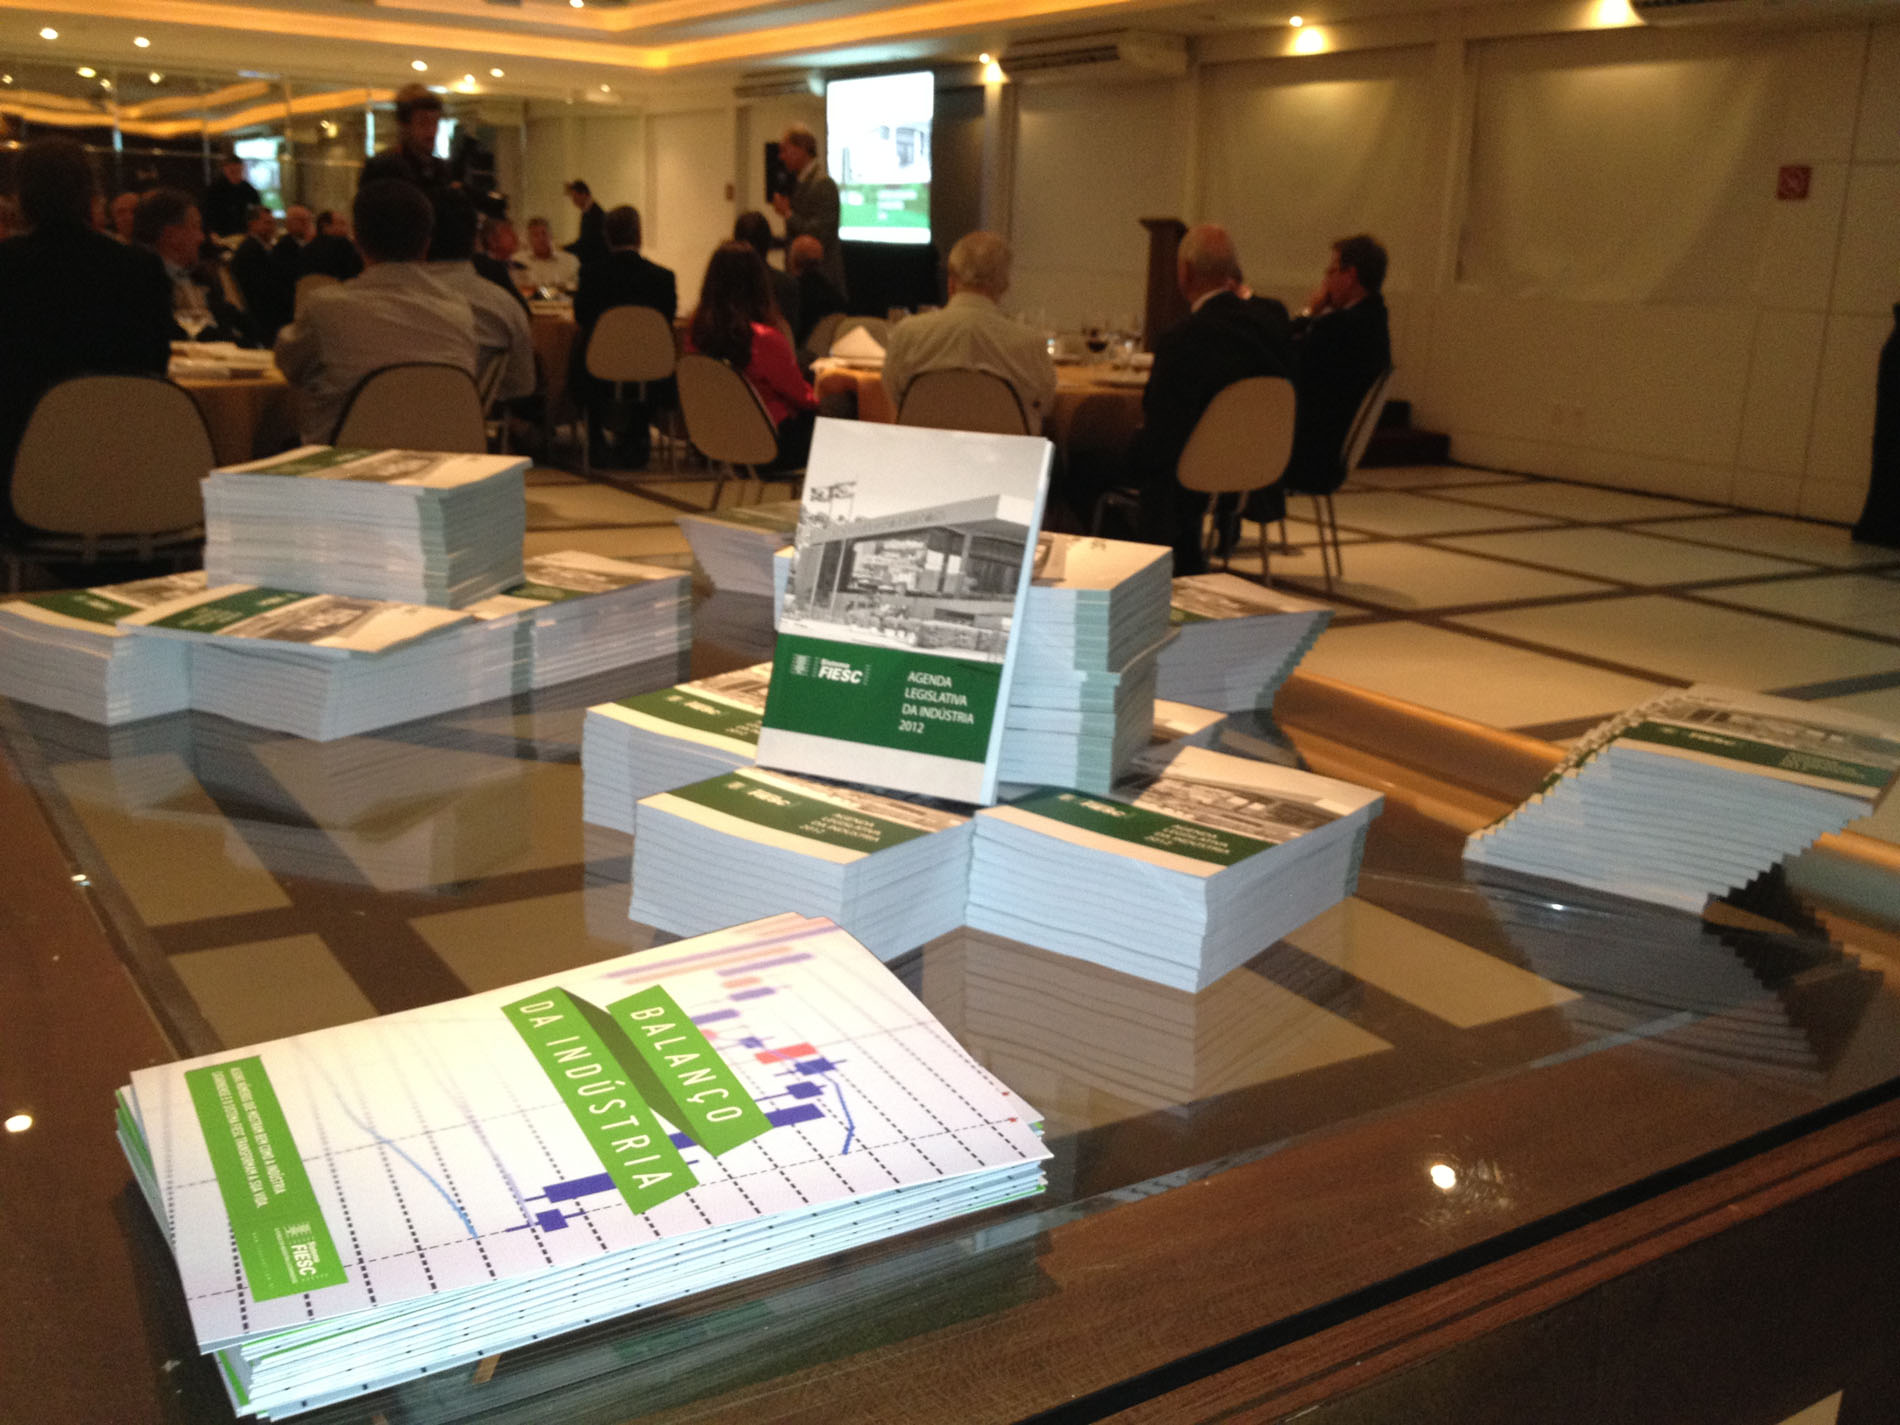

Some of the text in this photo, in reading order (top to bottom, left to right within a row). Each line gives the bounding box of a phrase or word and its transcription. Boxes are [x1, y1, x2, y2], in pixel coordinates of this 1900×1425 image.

[818, 665, 863, 684] FIESC
[906, 670, 953, 688] AGENDA
[904, 687, 968, 706] LEGISLATIVA
[901, 703, 975, 725] DA INDÚSTRIA
[898, 719, 925, 734] 2012
[630, 1006, 744, 1123] BALANÇO
[519, 1000, 673, 1190] DA INDÚSTRIA
[289, 1242, 317, 1277] FIESC
